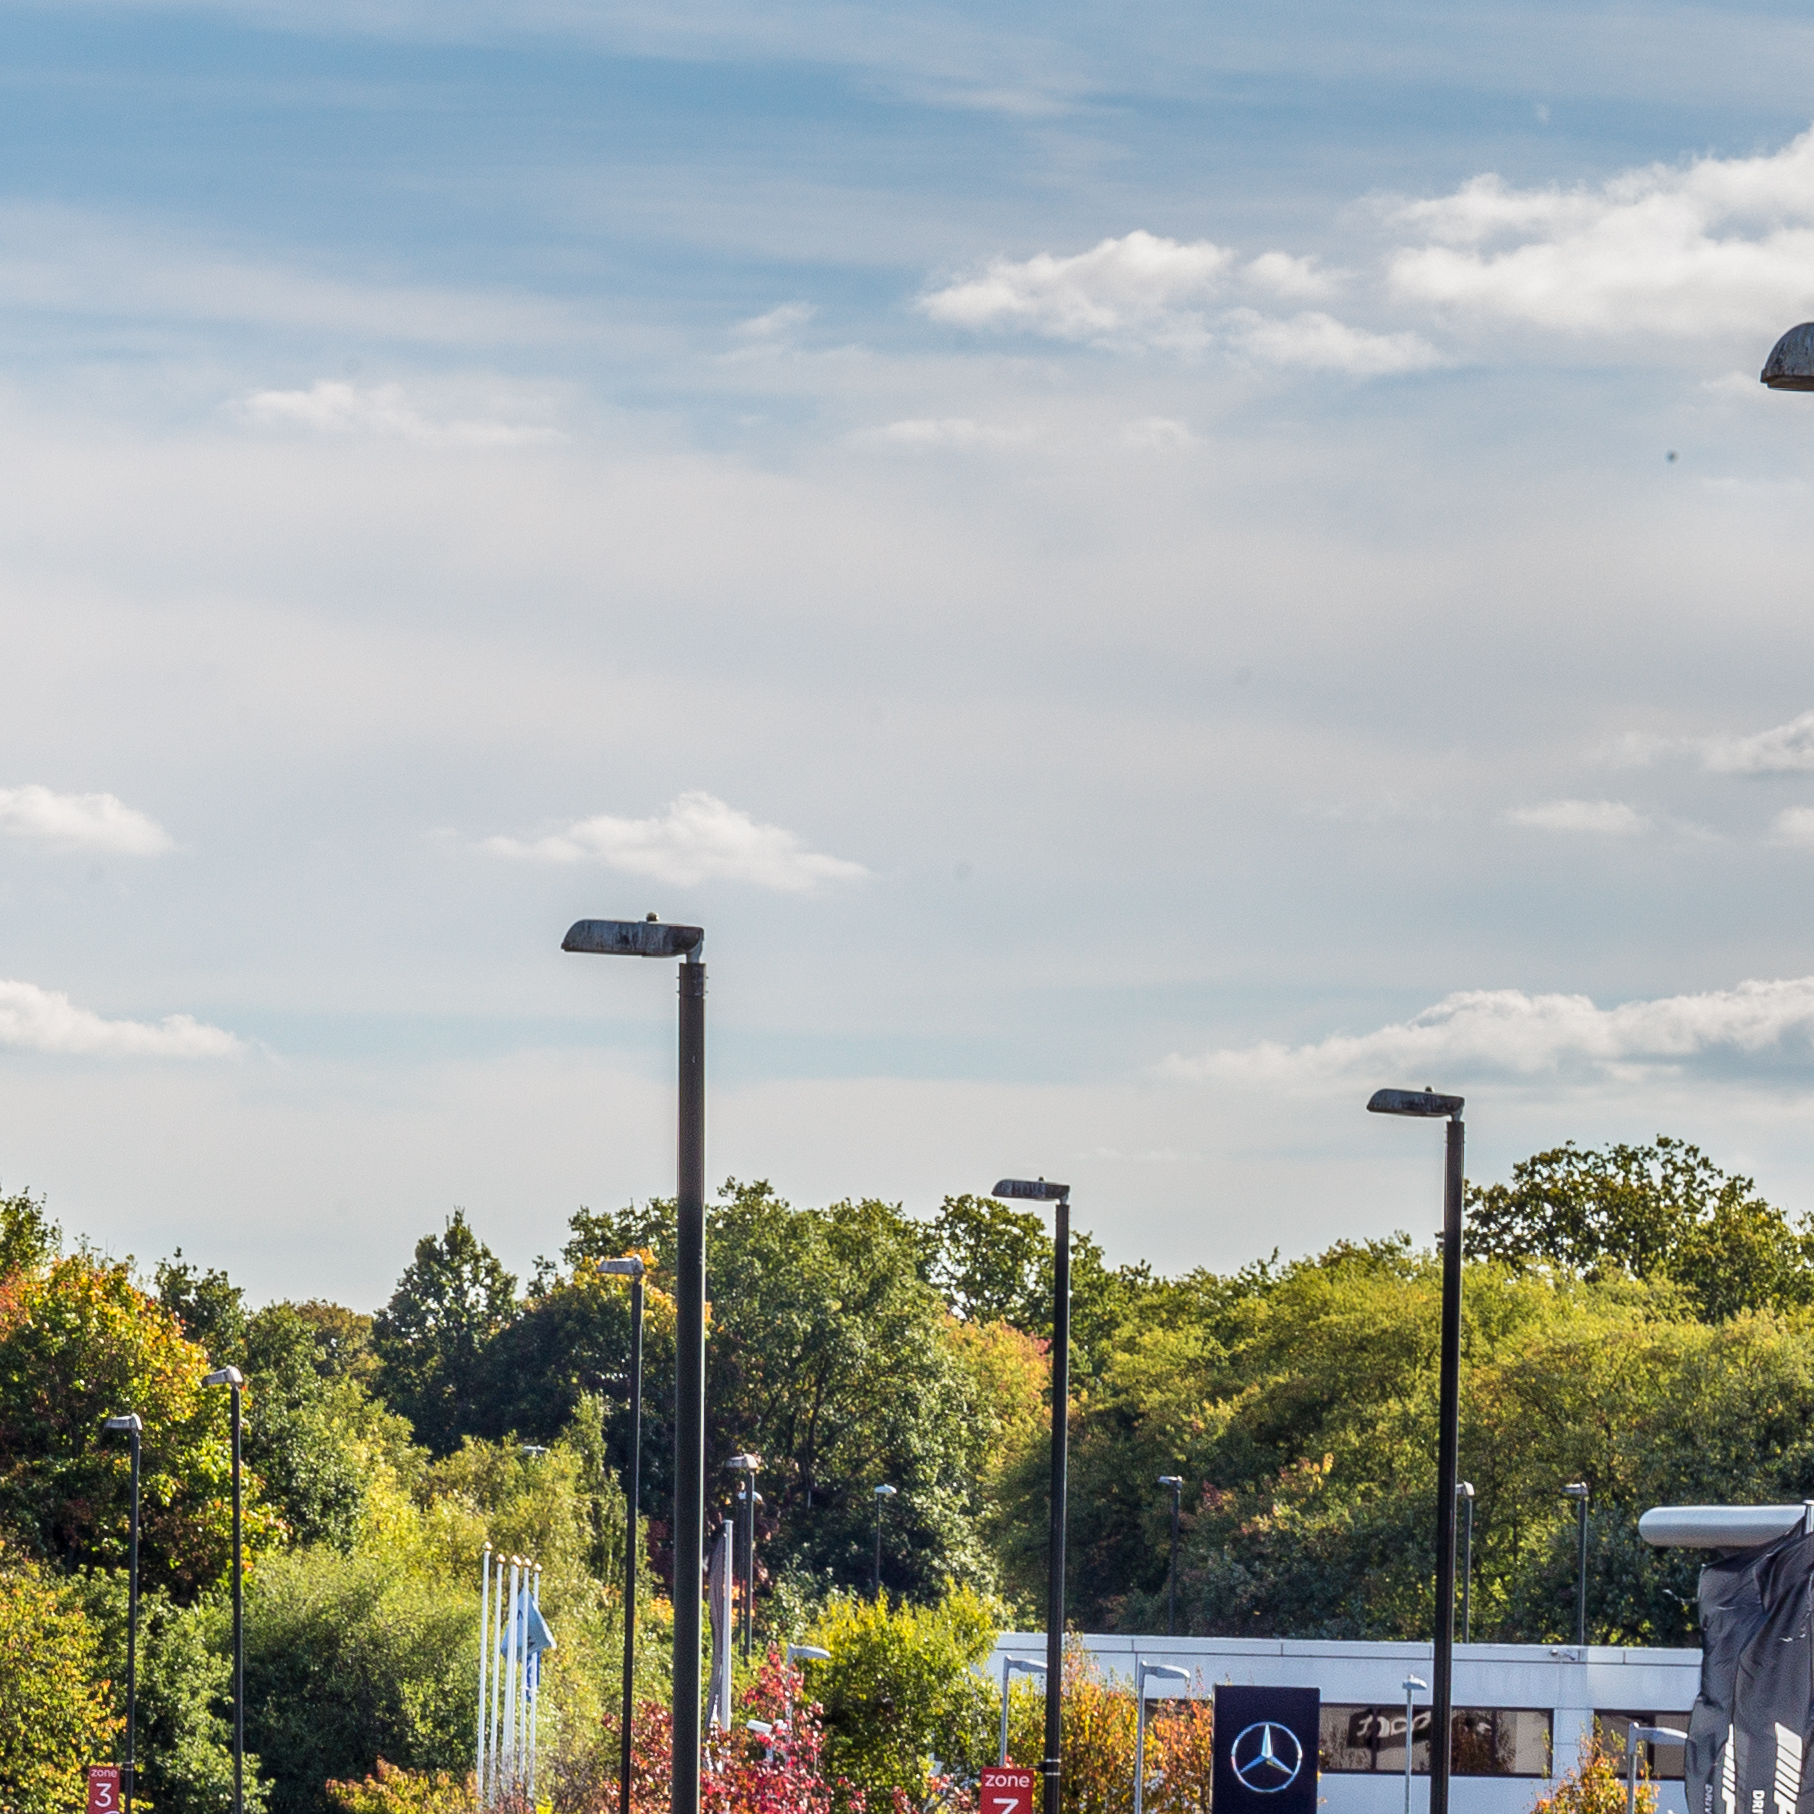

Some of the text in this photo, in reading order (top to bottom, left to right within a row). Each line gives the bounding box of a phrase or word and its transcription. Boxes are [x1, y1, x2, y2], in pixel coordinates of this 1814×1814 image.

[91, 1768, 118, 1778] zone
[984, 1774, 1031, 1788] zone
[94, 1782, 112, 1808] 3
